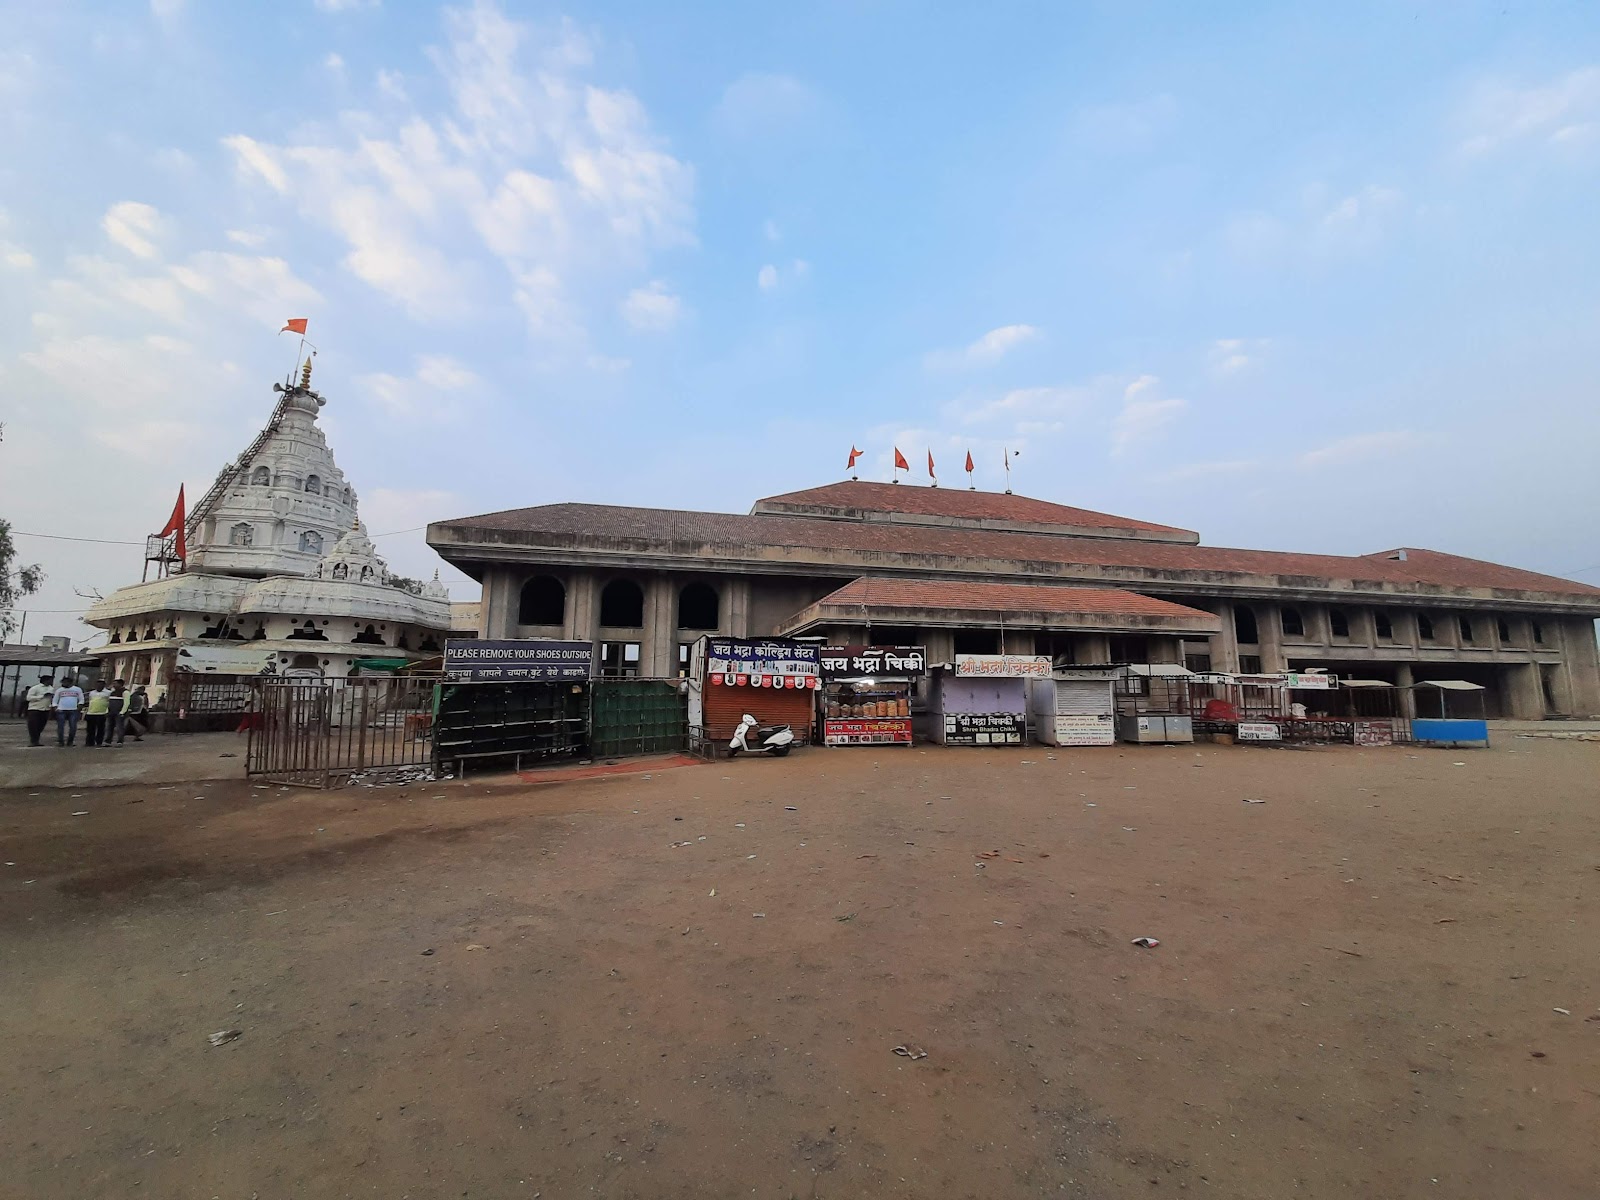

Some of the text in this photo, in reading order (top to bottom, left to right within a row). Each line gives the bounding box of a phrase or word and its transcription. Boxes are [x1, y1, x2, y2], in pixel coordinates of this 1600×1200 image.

[448, 649, 591, 659] PLEASE REMOVE YOUR SHOES OUTSIDE
[713, 645, 732, 656] जय
[734, 644, 752, 658] भद्रा
[821, 653, 923, 673] जय भद्रा चिक्की
[960, 657, 976, 673] श्री
[478, 666, 503, 677] आपले
